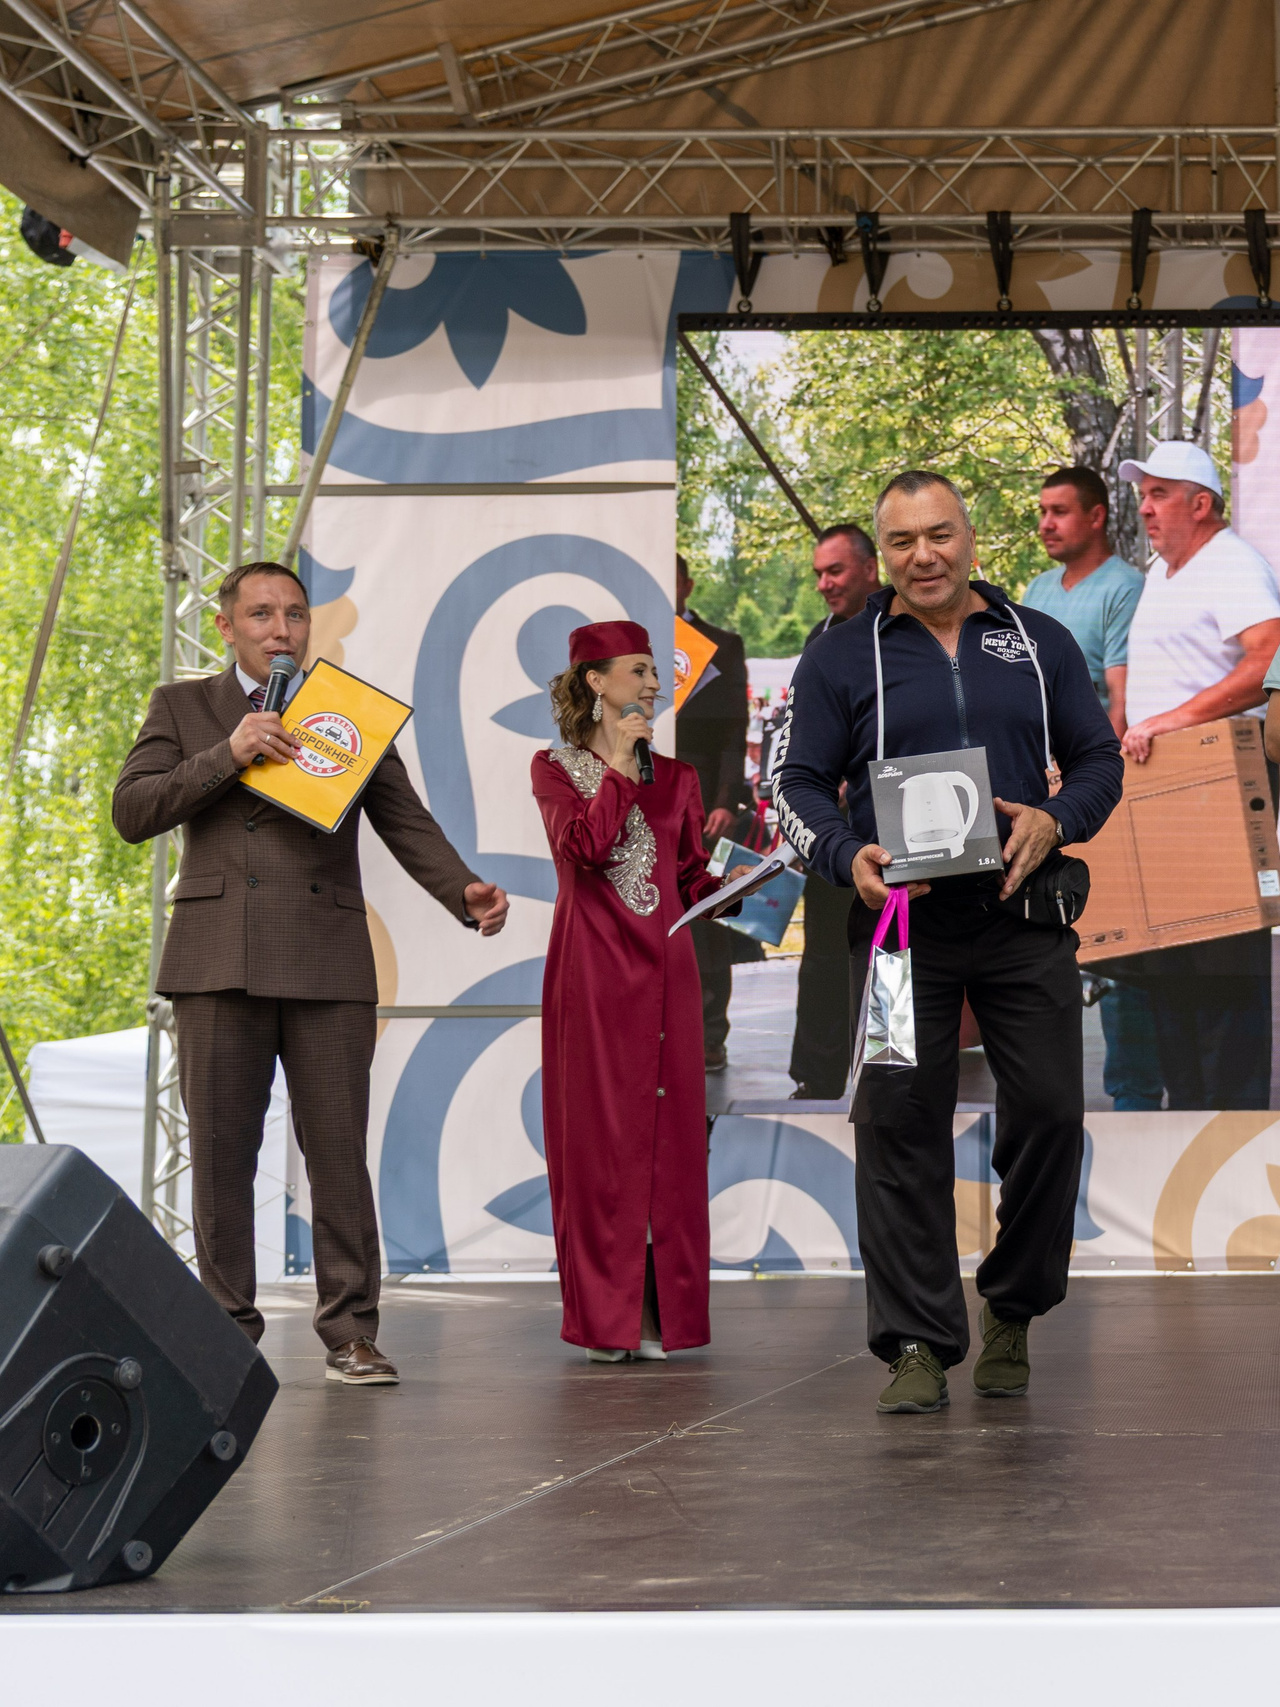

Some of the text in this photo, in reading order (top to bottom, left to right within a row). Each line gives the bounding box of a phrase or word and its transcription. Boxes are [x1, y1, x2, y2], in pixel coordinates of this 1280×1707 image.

[984, 637, 1035, 652] NEW YOR
[997, 647, 1021, 656] BOXING
[324, 716, 354, 736] КАЗАНЬ
[291, 727, 358, 768] ДОРОЖНОЕ
[308, 753, 325, 765] 88.9
[978, 858, 990, 866] 1.8
